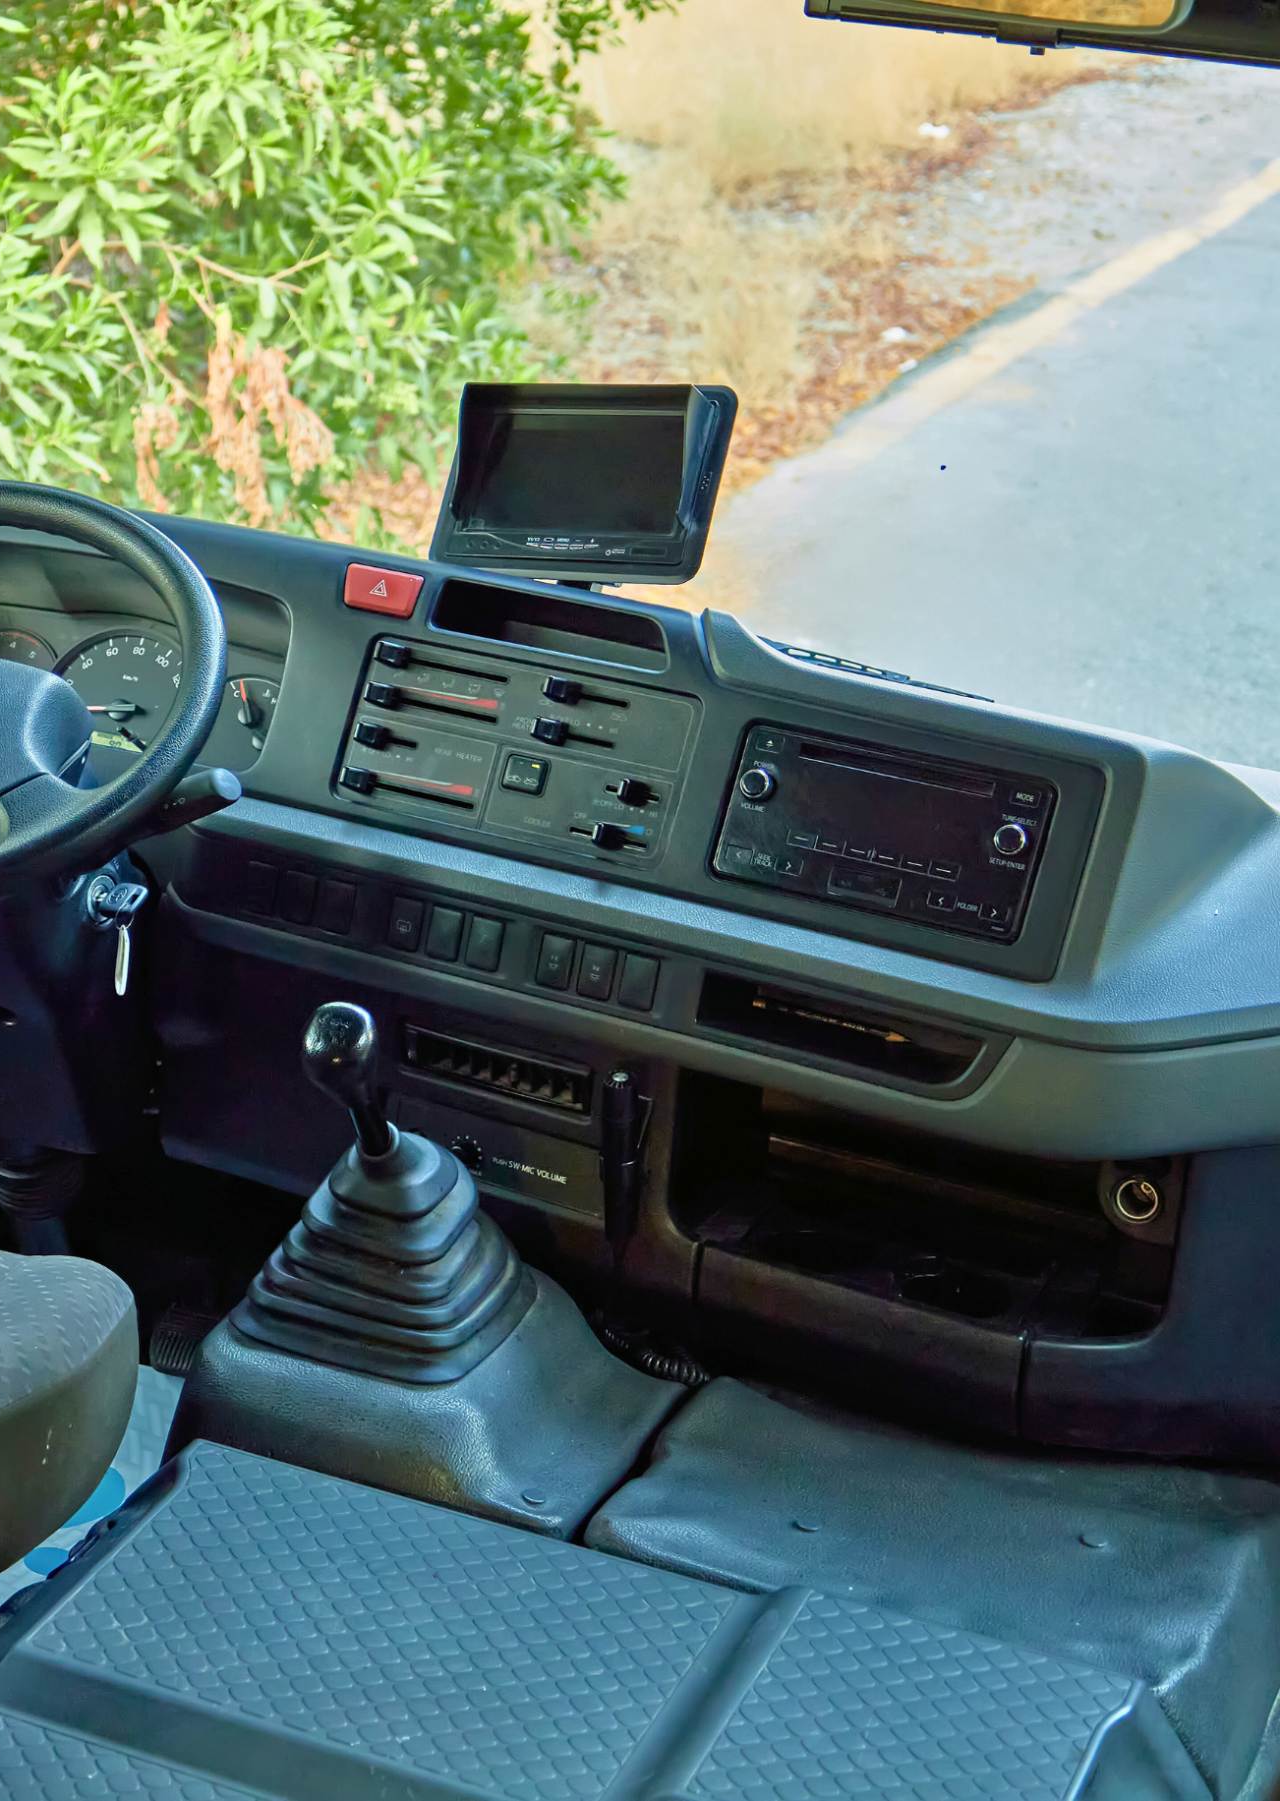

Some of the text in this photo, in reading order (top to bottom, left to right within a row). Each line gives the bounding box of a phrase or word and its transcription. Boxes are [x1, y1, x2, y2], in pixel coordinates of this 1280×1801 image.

[9, 641, 17, 649] 4
[28, 651, 37, 659] 5
[105, 646, 119, 657] 60
[132, 646, 146, 656] 80
[81, 657, 94, 670] 40
[154, 654, 170, 668] 100
[122, 674, 139, 682] km/h
[233, 690, 241, 698] C
[456, 752, 482, 762] HEATER
[753, 760, 775, 770] POWER
[1015, 792, 1035, 803] MODE
[740, 802, 765, 812] VOLUME
[523, 816, 550, 827] COOLER
[757, 852, 772, 861] SEEK
[754, 857, 772, 868] TRACK
[956, 901, 978, 912] FOLDER
[491, 1156, 508, 1166] PUSH
[536, 1169, 566, 1184] VOLUME
